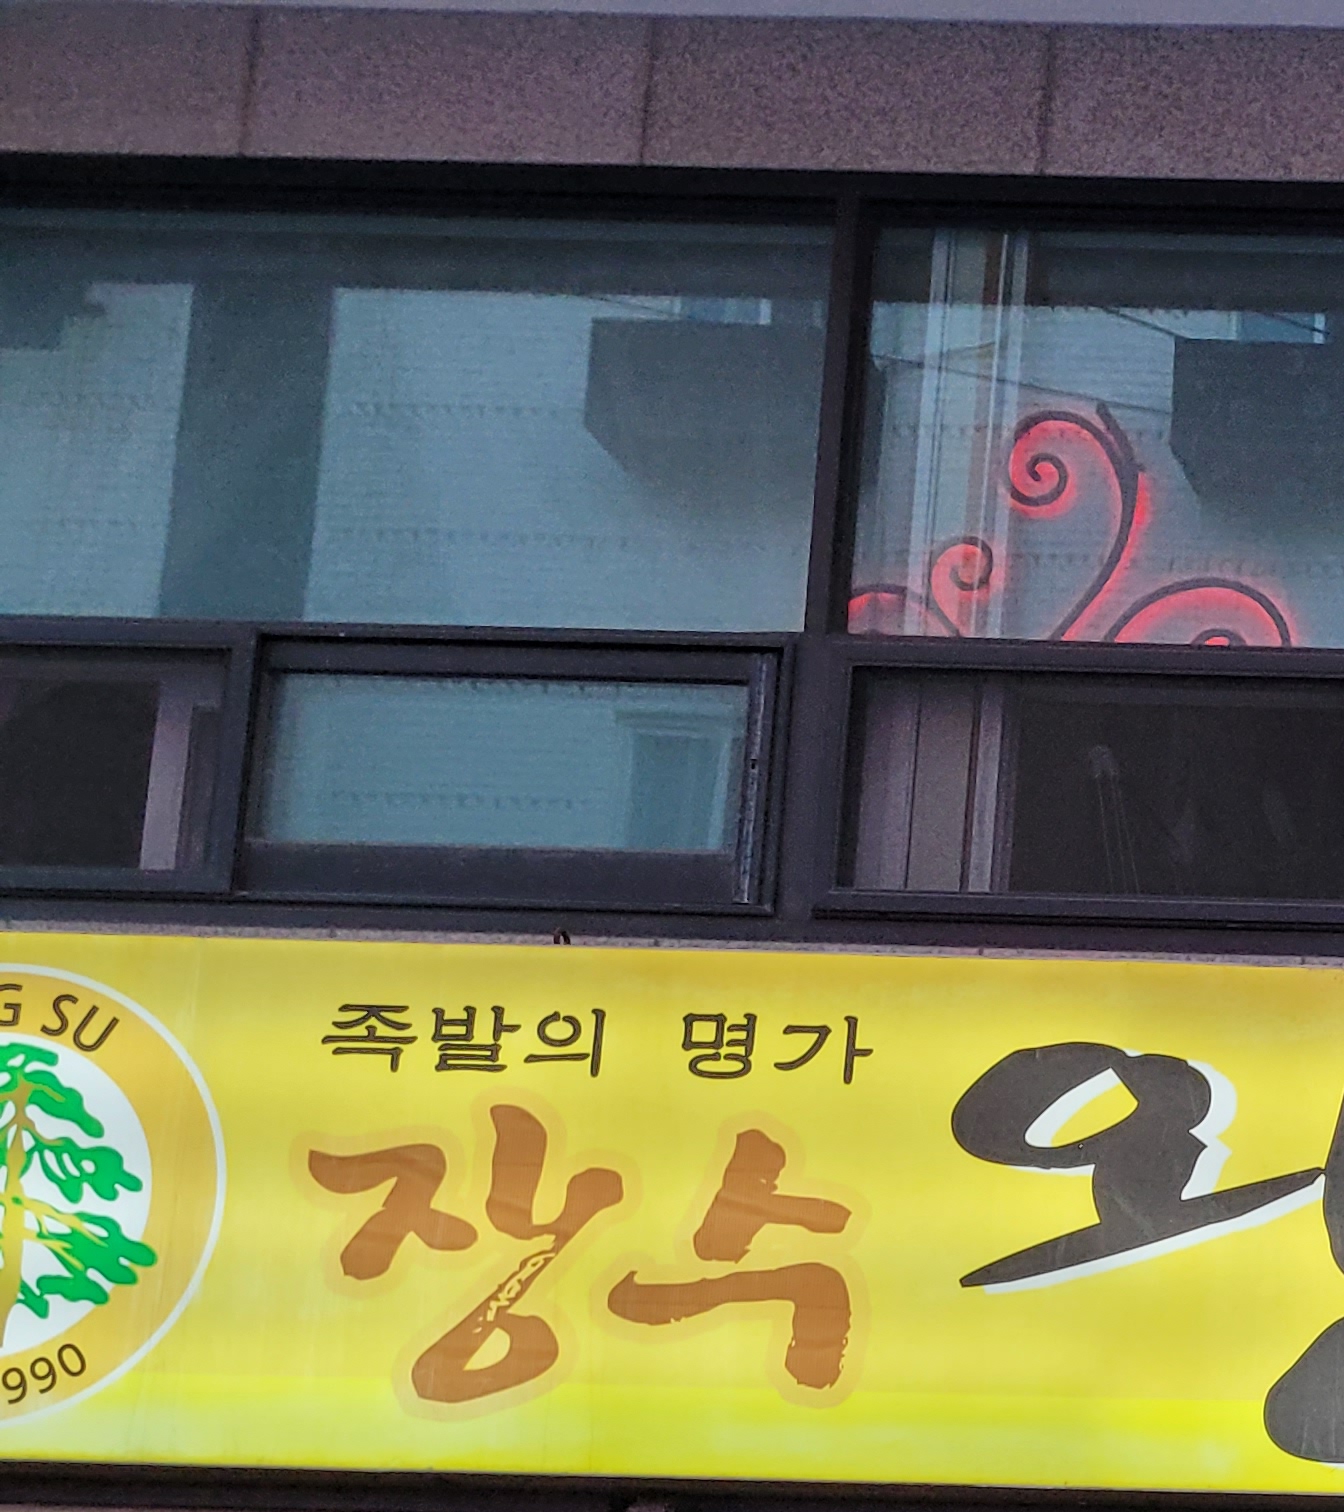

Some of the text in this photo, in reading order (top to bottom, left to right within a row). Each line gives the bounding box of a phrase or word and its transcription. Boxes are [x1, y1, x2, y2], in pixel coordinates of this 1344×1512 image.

[41, 994, 119, 1052] SU
[322, 1004, 873, 1085] 족발의 명가
[308, 1104, 852, 1403] 장수
